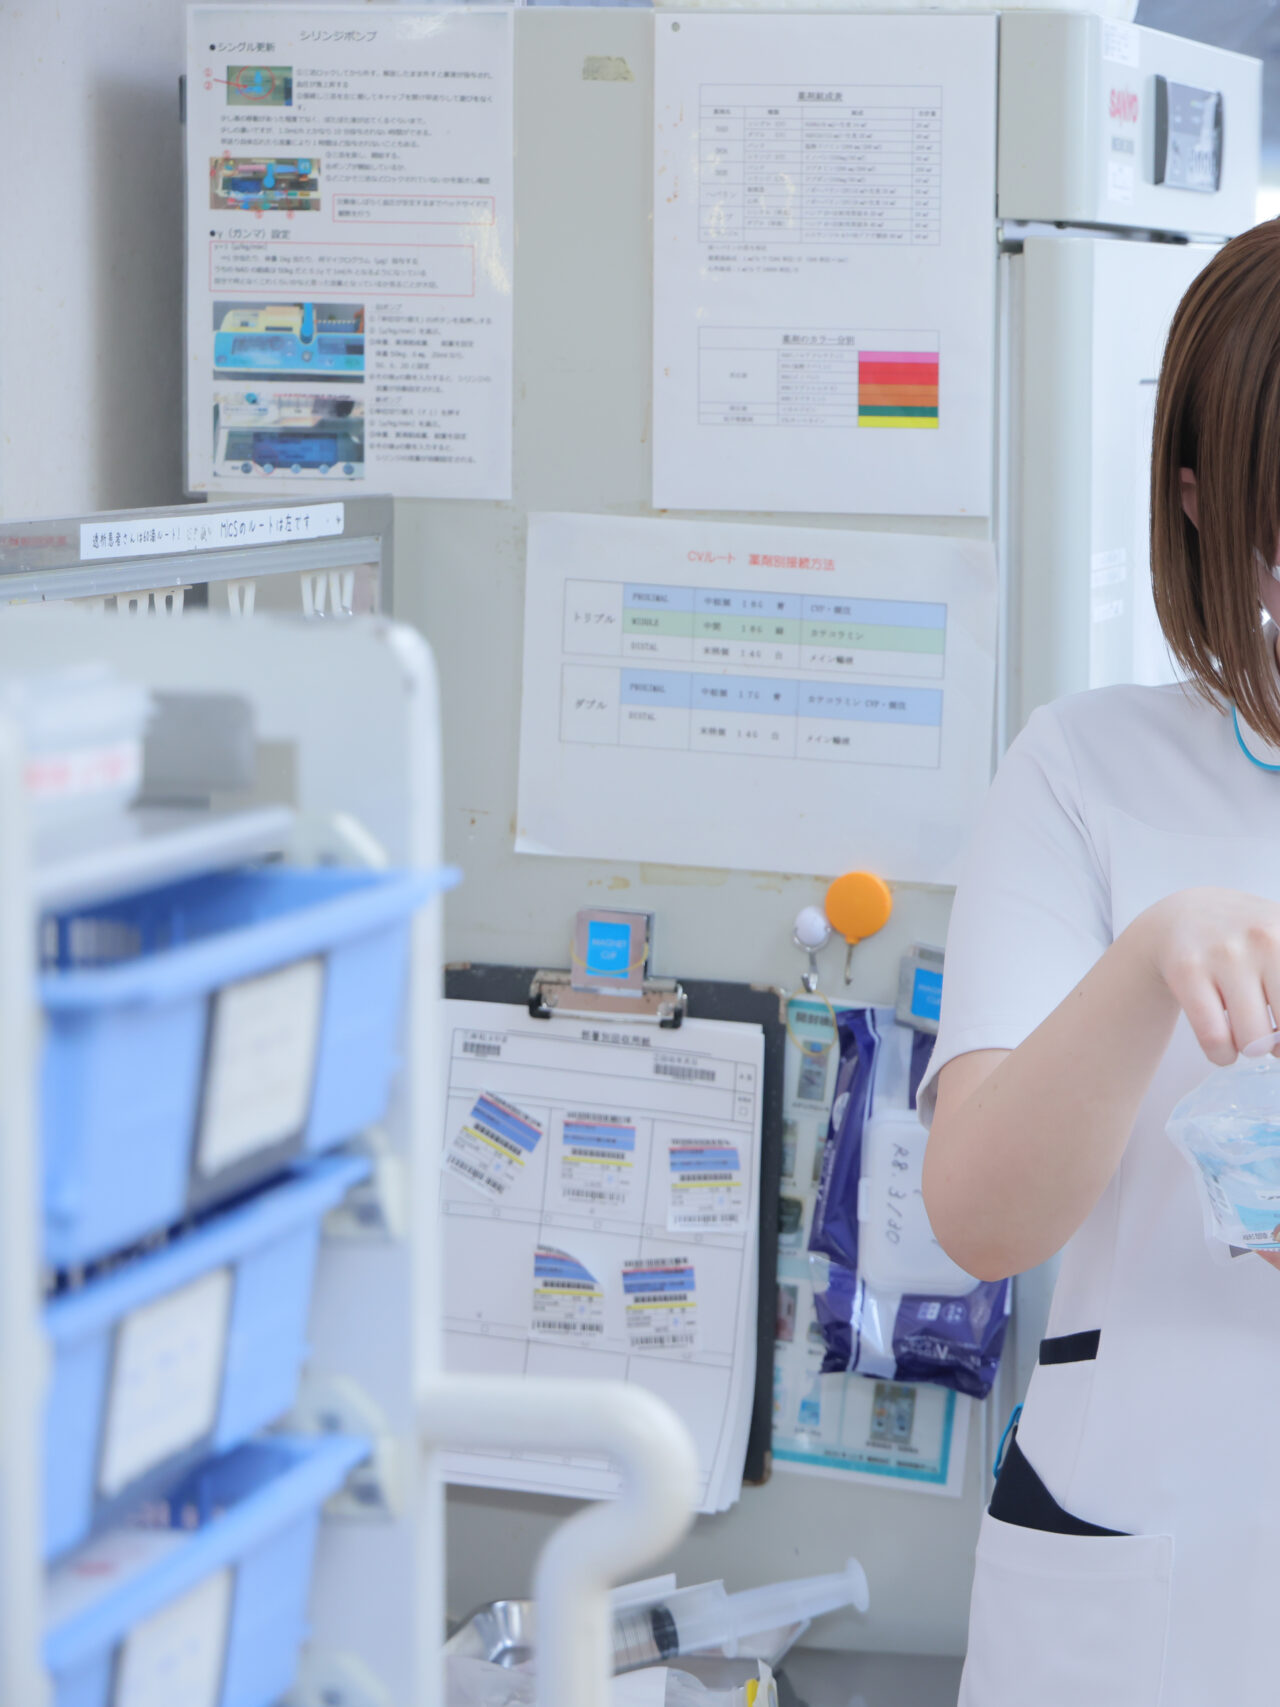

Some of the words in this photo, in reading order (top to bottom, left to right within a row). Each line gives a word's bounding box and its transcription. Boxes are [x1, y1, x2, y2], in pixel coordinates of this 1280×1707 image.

[299, 29, 377, 42] シリンジポンプ
[574, 611, 617, 624] トリプル
[574, 697, 608, 710] ダブル
